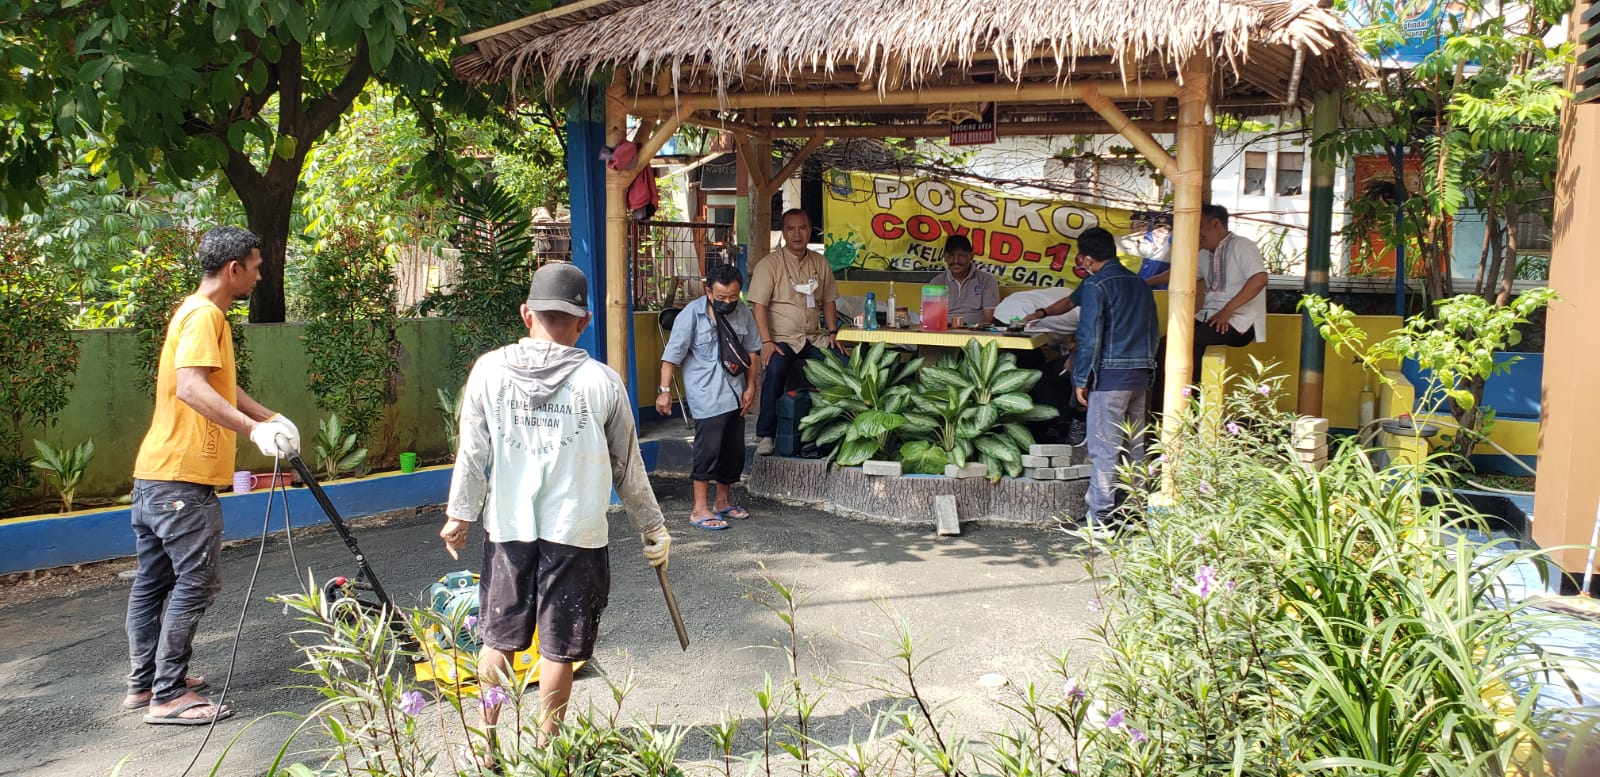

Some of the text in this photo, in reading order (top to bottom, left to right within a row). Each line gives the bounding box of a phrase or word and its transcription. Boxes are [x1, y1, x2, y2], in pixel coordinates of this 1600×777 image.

[952, 122, 992, 132] SMOKING AREA
[873, 177, 1099, 240] POSKO
[1011, 266, 1066, 288] GAGA
